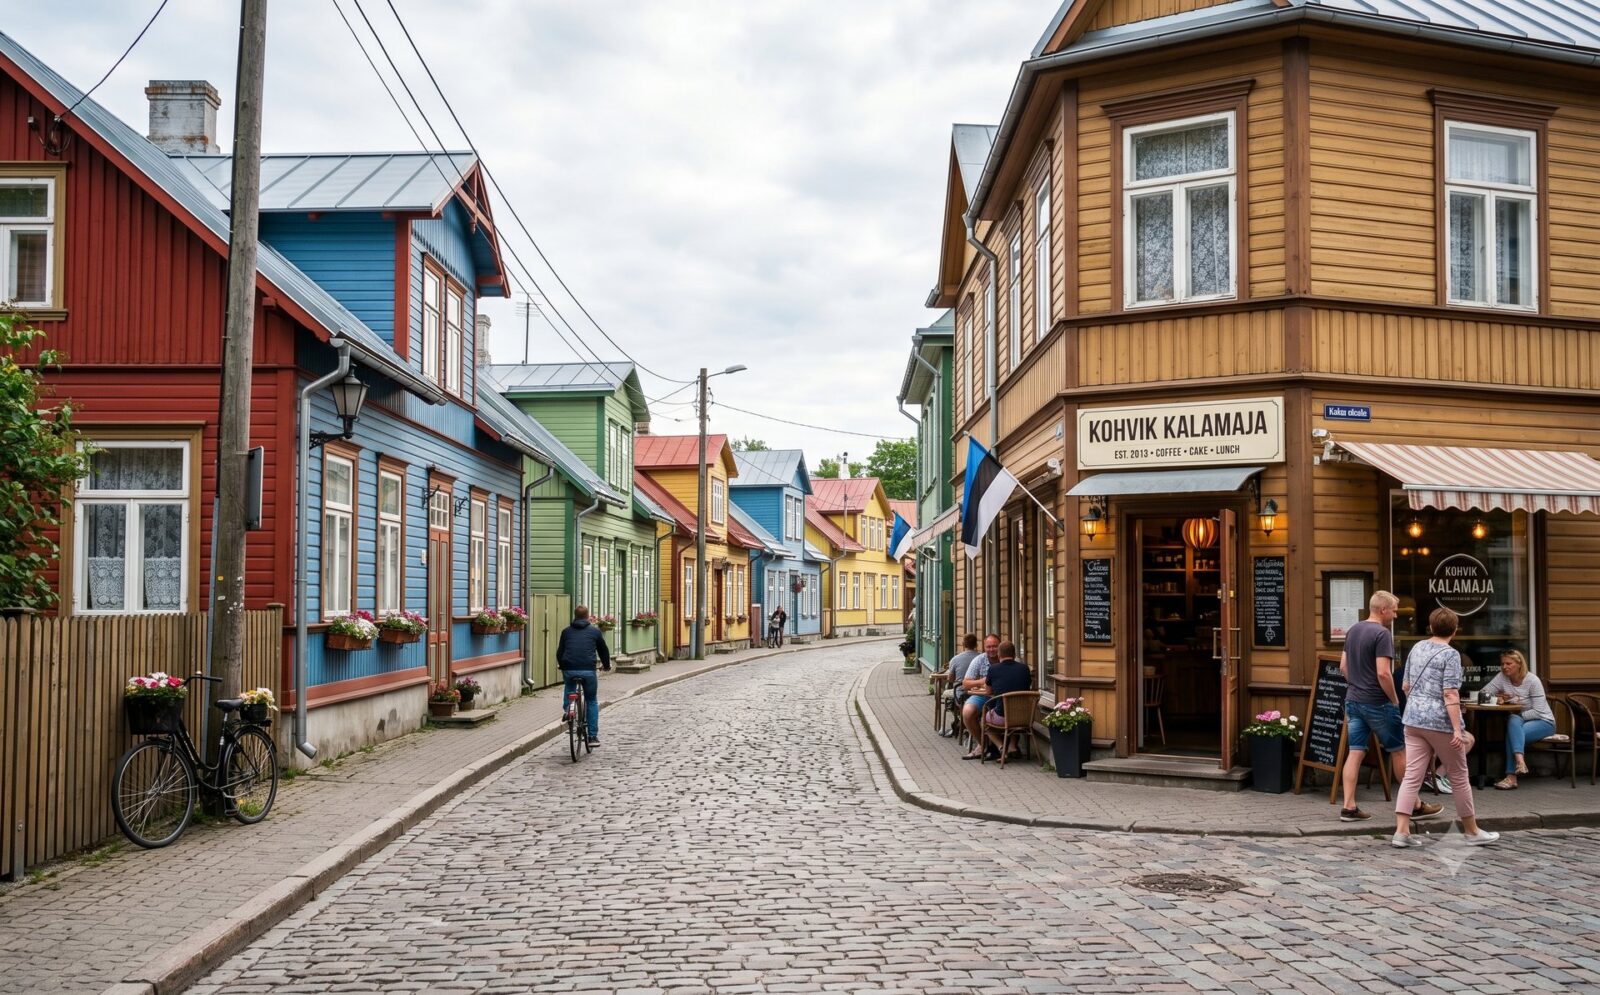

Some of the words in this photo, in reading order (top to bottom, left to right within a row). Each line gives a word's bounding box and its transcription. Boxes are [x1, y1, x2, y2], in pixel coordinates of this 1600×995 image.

[1089, 416, 1158, 443] KOHVIK
[1163, 410, 1268, 439] KALAMAJA
[1114, 450, 1129, 459] EST.
[1130, 449, 1149, 459] 2013
[1155, 447, 1182, 458] COFFEE
[1189, 446, 1209, 456] CAKE
[1215, 444, 1240, 455] LUNCH
[1445, 566, 1478, 577] KOHVIK
[1428, 578, 1495, 594] KALAMAJA
